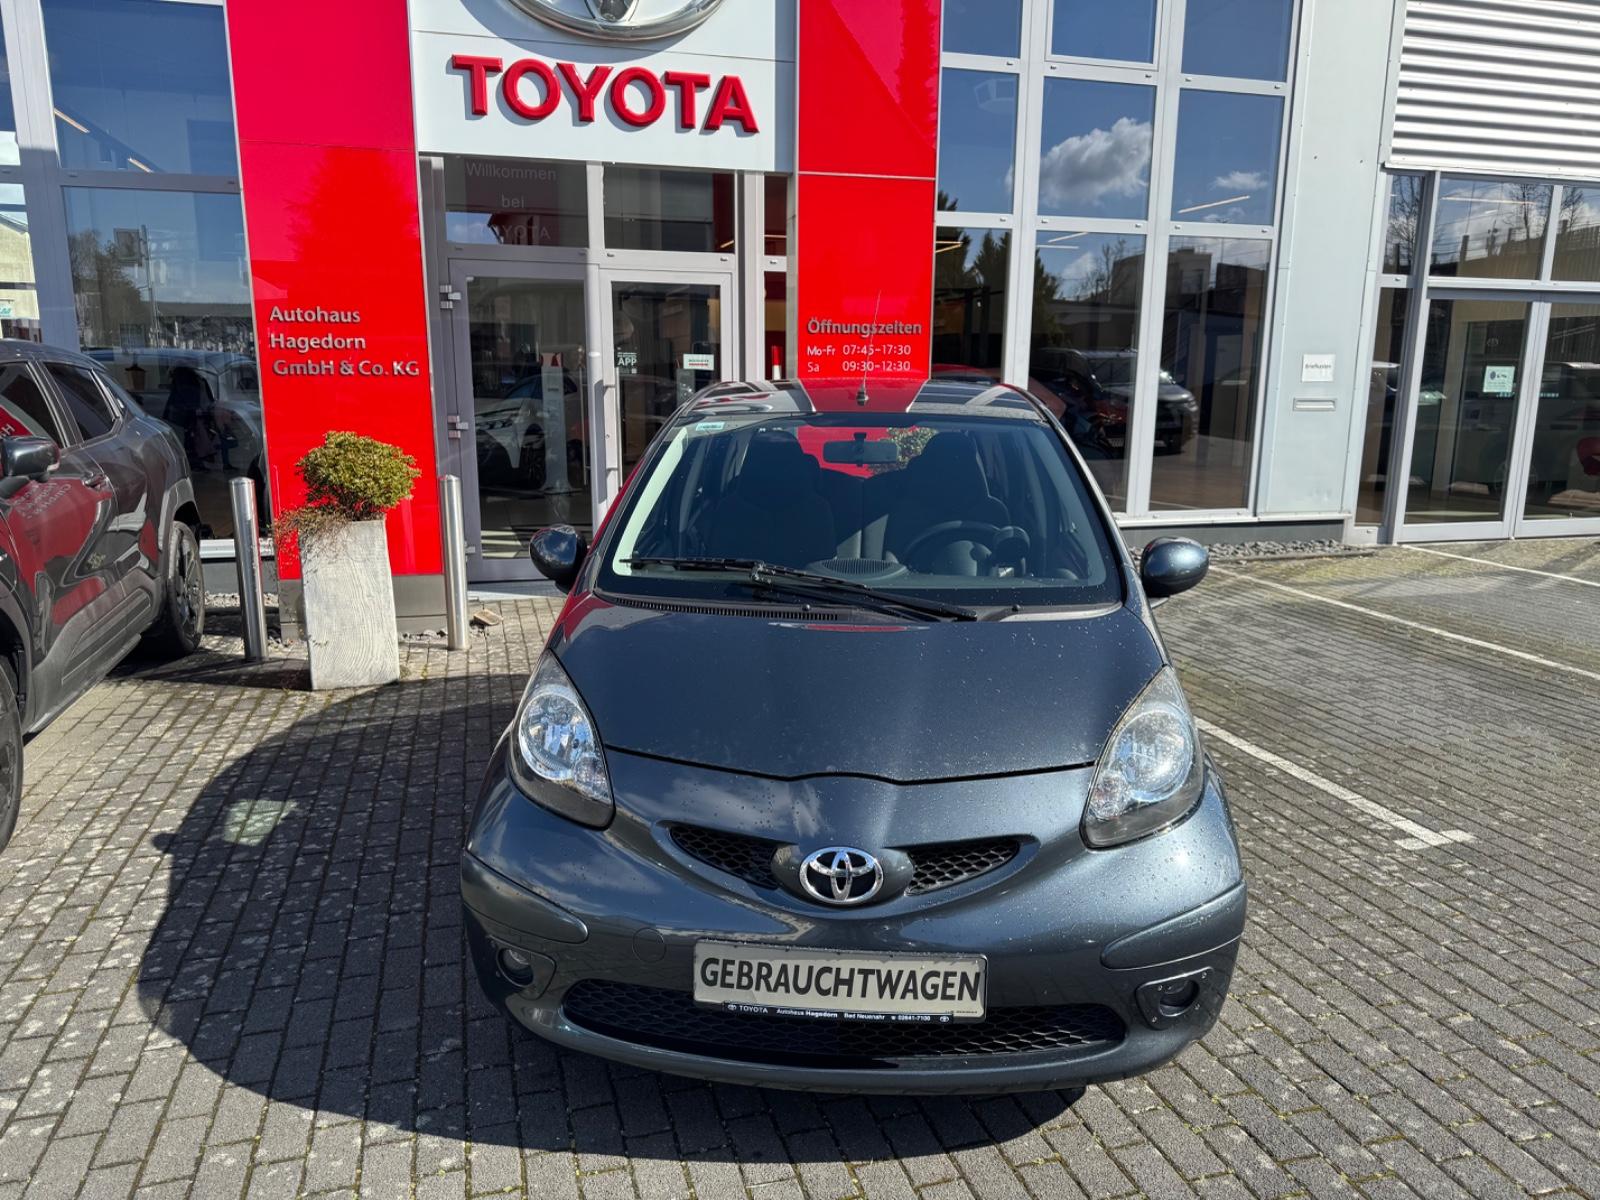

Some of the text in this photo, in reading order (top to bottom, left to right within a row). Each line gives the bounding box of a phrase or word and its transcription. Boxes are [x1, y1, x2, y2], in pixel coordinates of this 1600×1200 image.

[452, 53, 759, 134] TOYOTA
[466, 162, 556, 180] Willkommen
[501, 193, 525, 208] bei
[270, 306, 361, 323] Autohaus
[807, 317, 922, 338] Öffnungszeiten
[270, 333, 367, 353] Hagedorn
[807, 344, 911, 356] Mo-Fr 07:45-17:30
[273, 359, 420, 376] GmbH & Co. KG
[618, 357, 637, 366] APP
[807, 361, 911, 373] Sa 09:30-12:30
[700, 957, 981, 1001] GEBRAUCHTWAGEN
[739, 1005, 769, 1014] TOYOTA
[805, 1010, 838, 1018] Hagedorn
